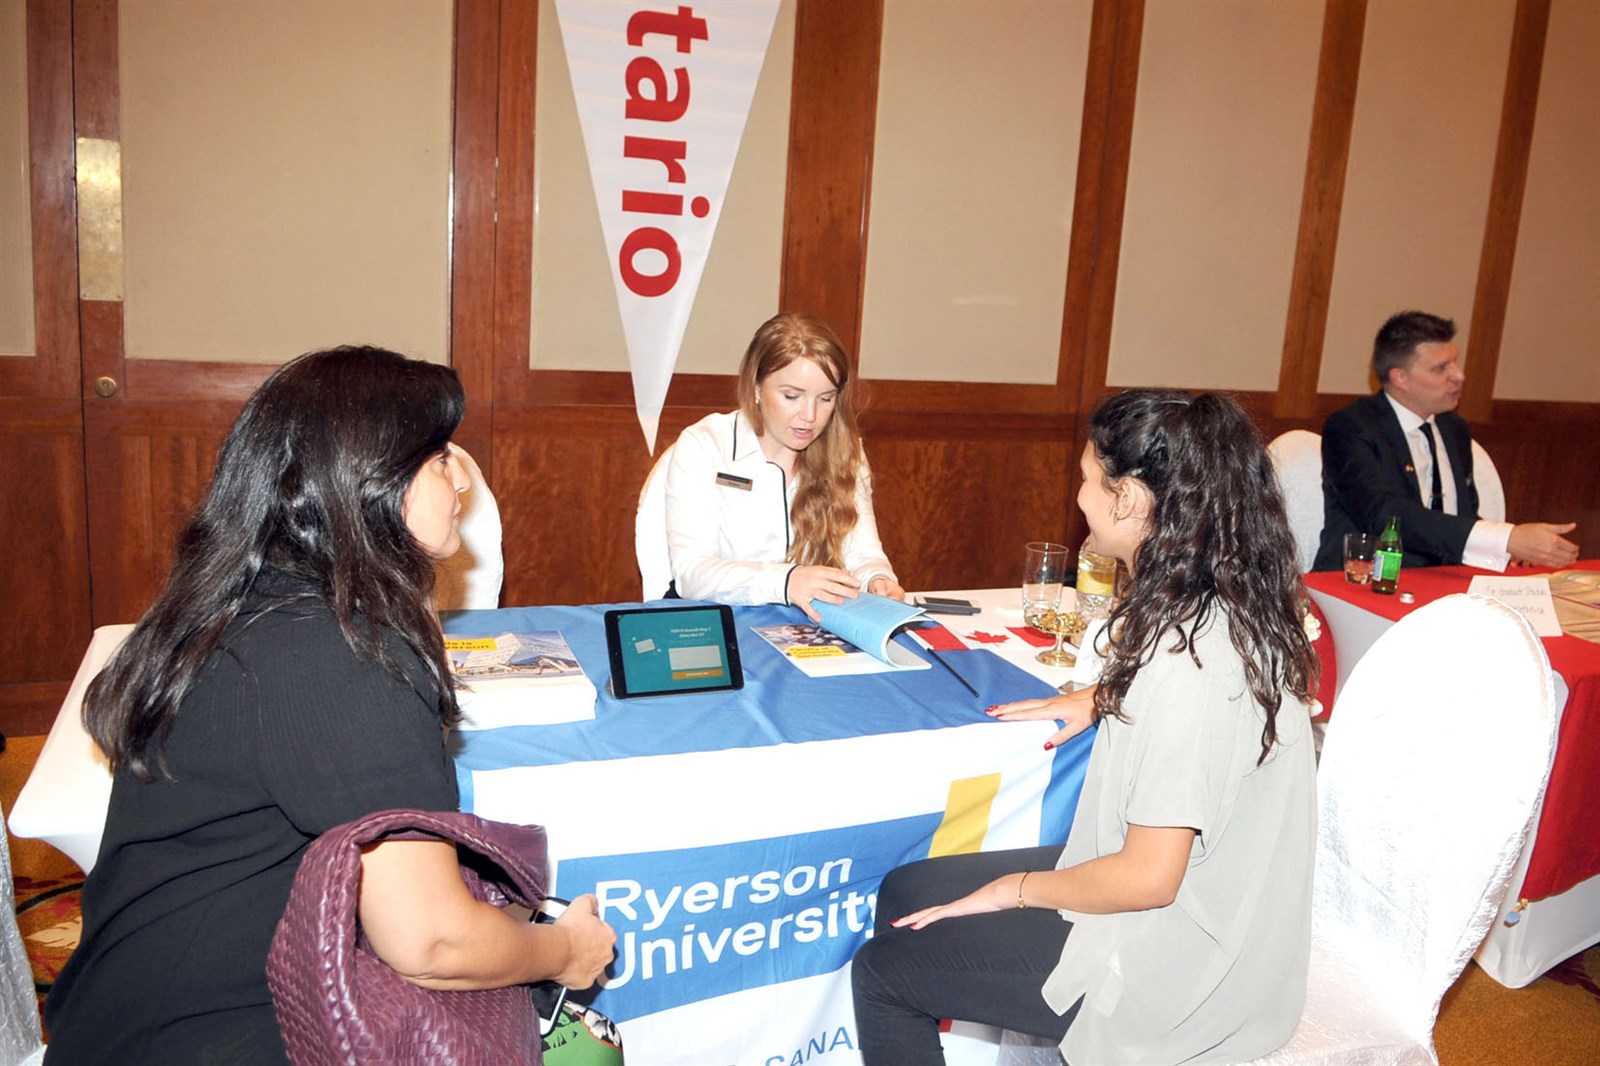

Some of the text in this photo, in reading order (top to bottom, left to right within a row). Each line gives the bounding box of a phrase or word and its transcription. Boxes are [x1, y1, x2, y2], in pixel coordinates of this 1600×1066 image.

[619, 5, 710, 297] tario
[595, 857, 853, 931] Ryerson
[765, 1026, 861, 1066] CANA
